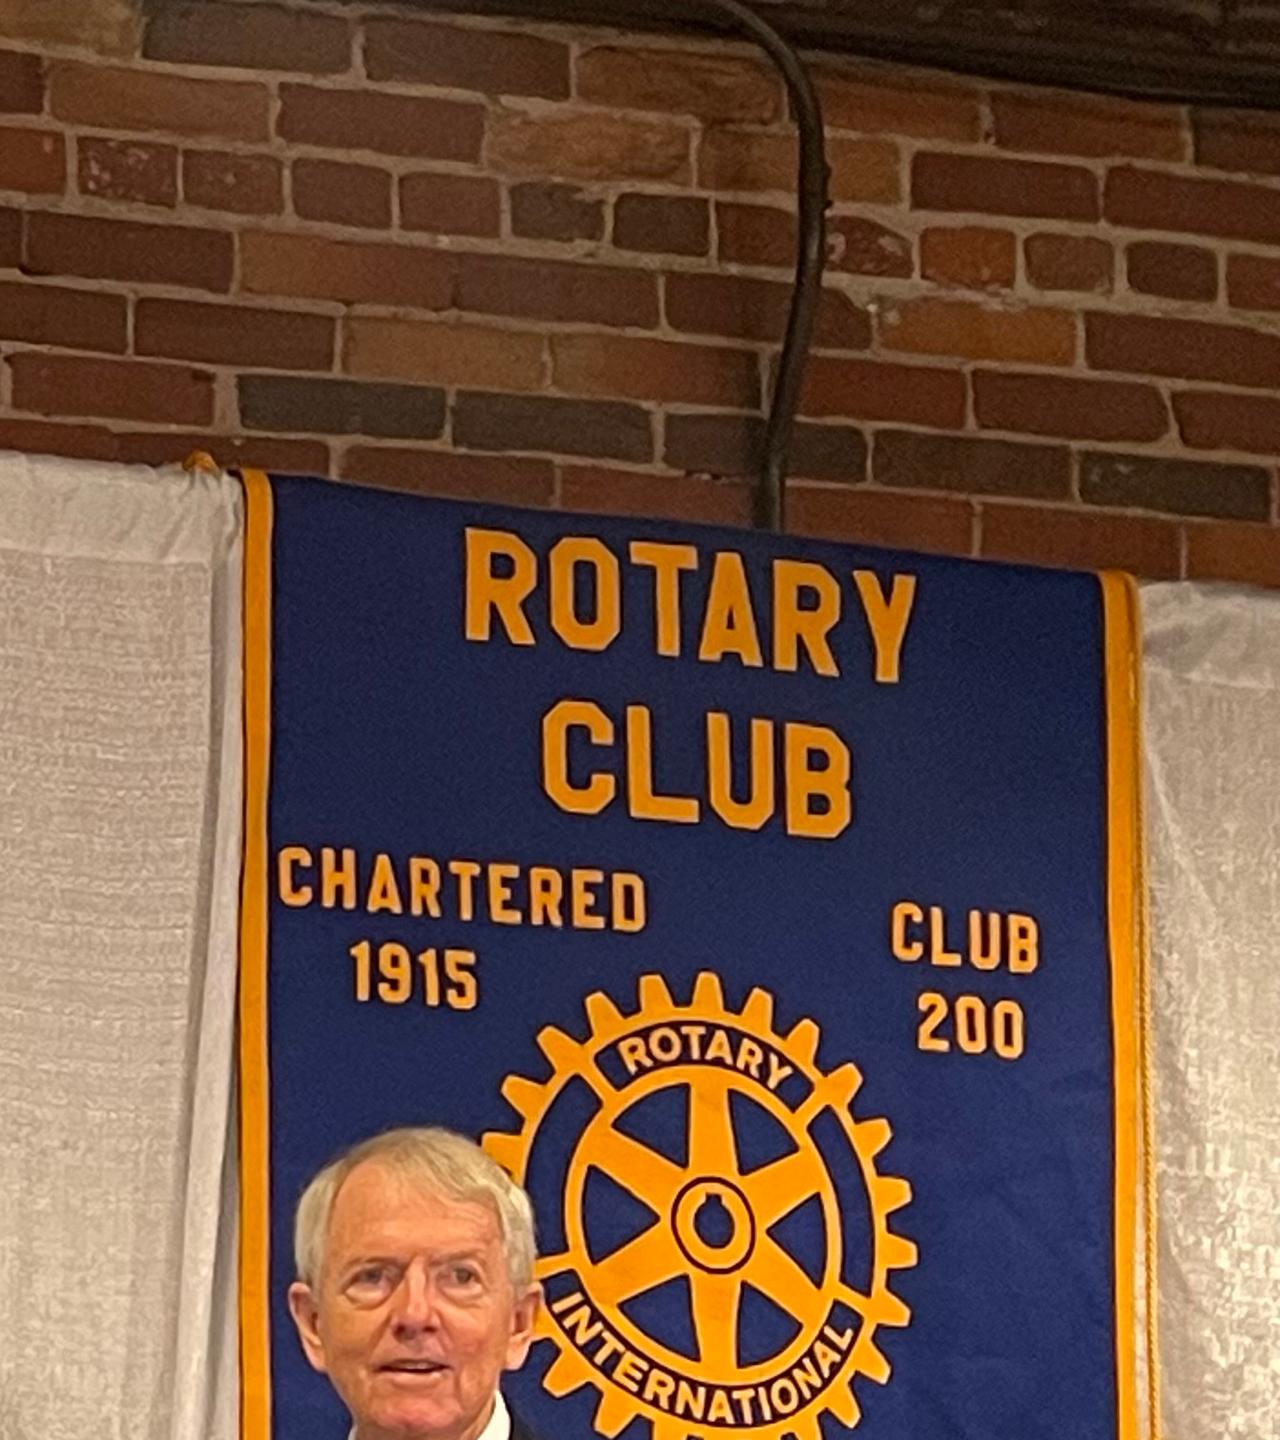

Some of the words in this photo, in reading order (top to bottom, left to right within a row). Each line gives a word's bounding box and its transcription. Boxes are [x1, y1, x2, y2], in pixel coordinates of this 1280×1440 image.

[464, 526, 916, 684] ROTARY
[541, 699, 852, 839] CLUB
[277, 846, 647, 933] CHARTERED
[349, 940, 479, 1010] 1915
[891, 901, 1039, 974] CLUB
[617, 1024, 794, 1091] ROTARY
[917, 992, 1025, 1060] 200
[551, 1291, 854, 1426] INTERNATIONAL
